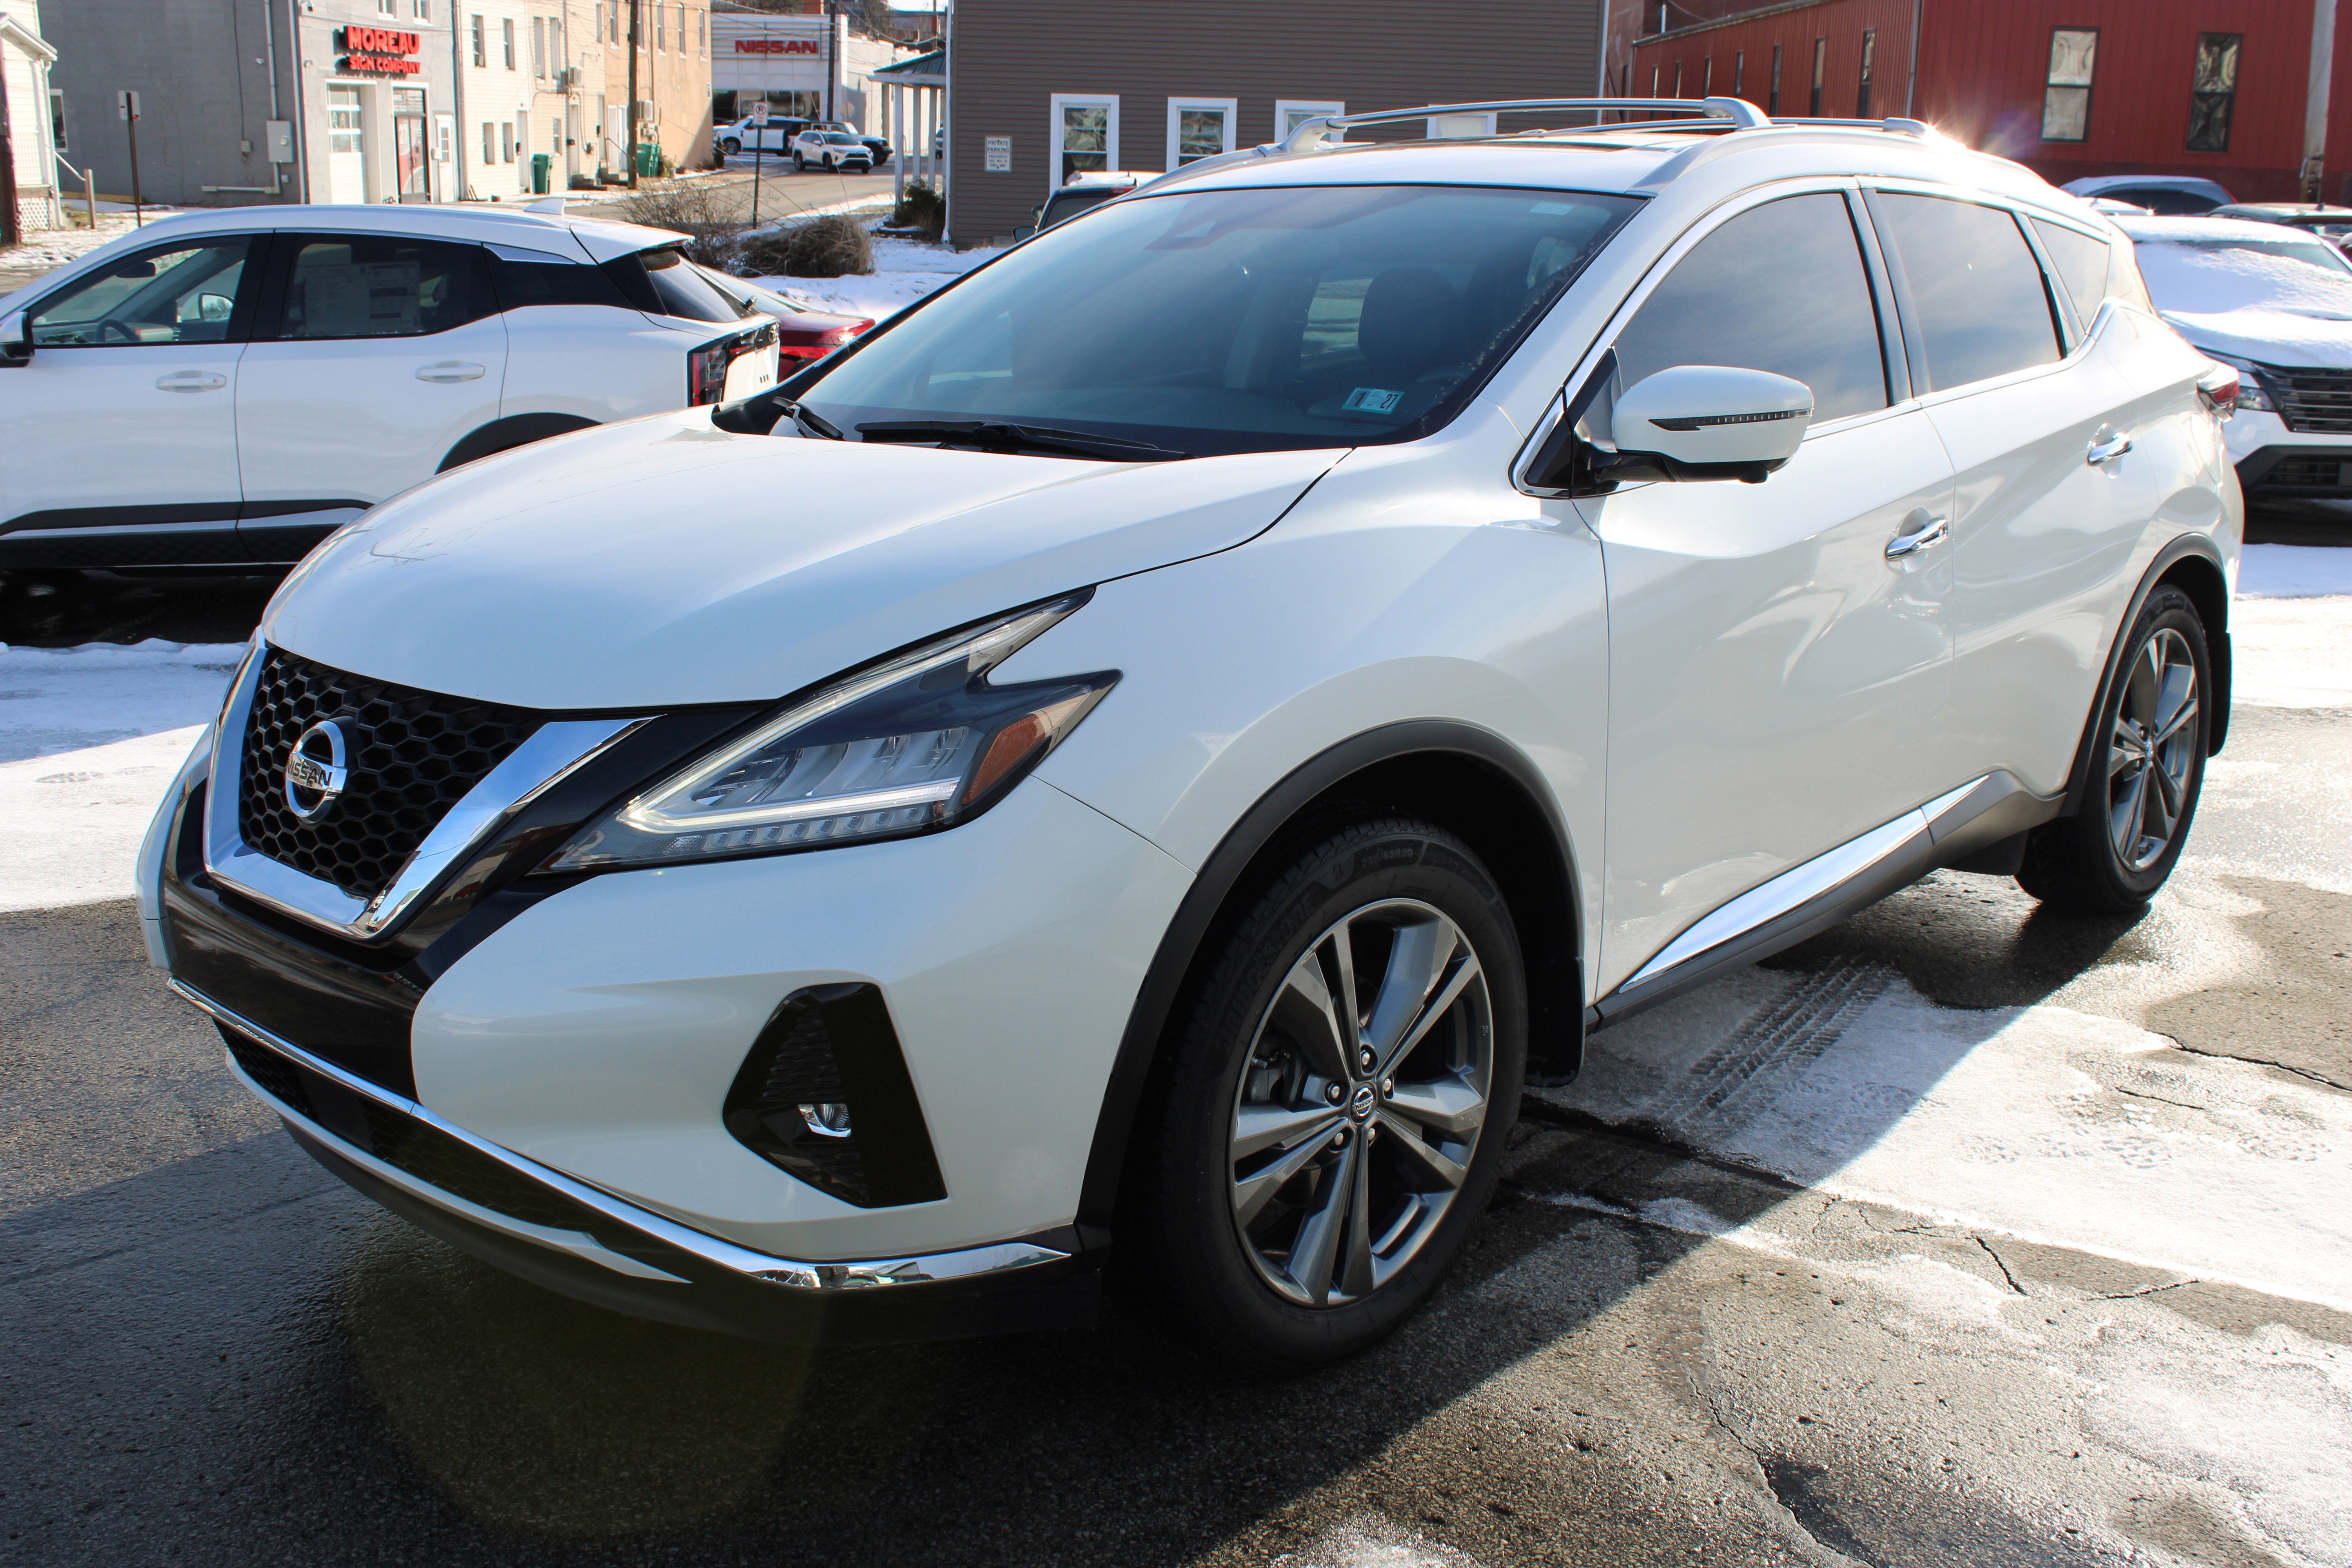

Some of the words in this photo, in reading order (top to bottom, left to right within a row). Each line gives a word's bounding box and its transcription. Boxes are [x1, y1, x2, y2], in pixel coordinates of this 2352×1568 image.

[347, 25, 419, 54] MOREAU
[735, 40, 817, 53] NISSAN
[349, 55, 375, 71] SIGN
[376, 57, 420, 74] COMPANY
[1354, 392, 1367, 407] 1
[1379, 393, 1399, 410] 27
[287, 760, 333, 786] NISSAN
[1361, 848, 1414, 869] 235/55R20
[1356, 1098, 1373, 1109] NISSAN
